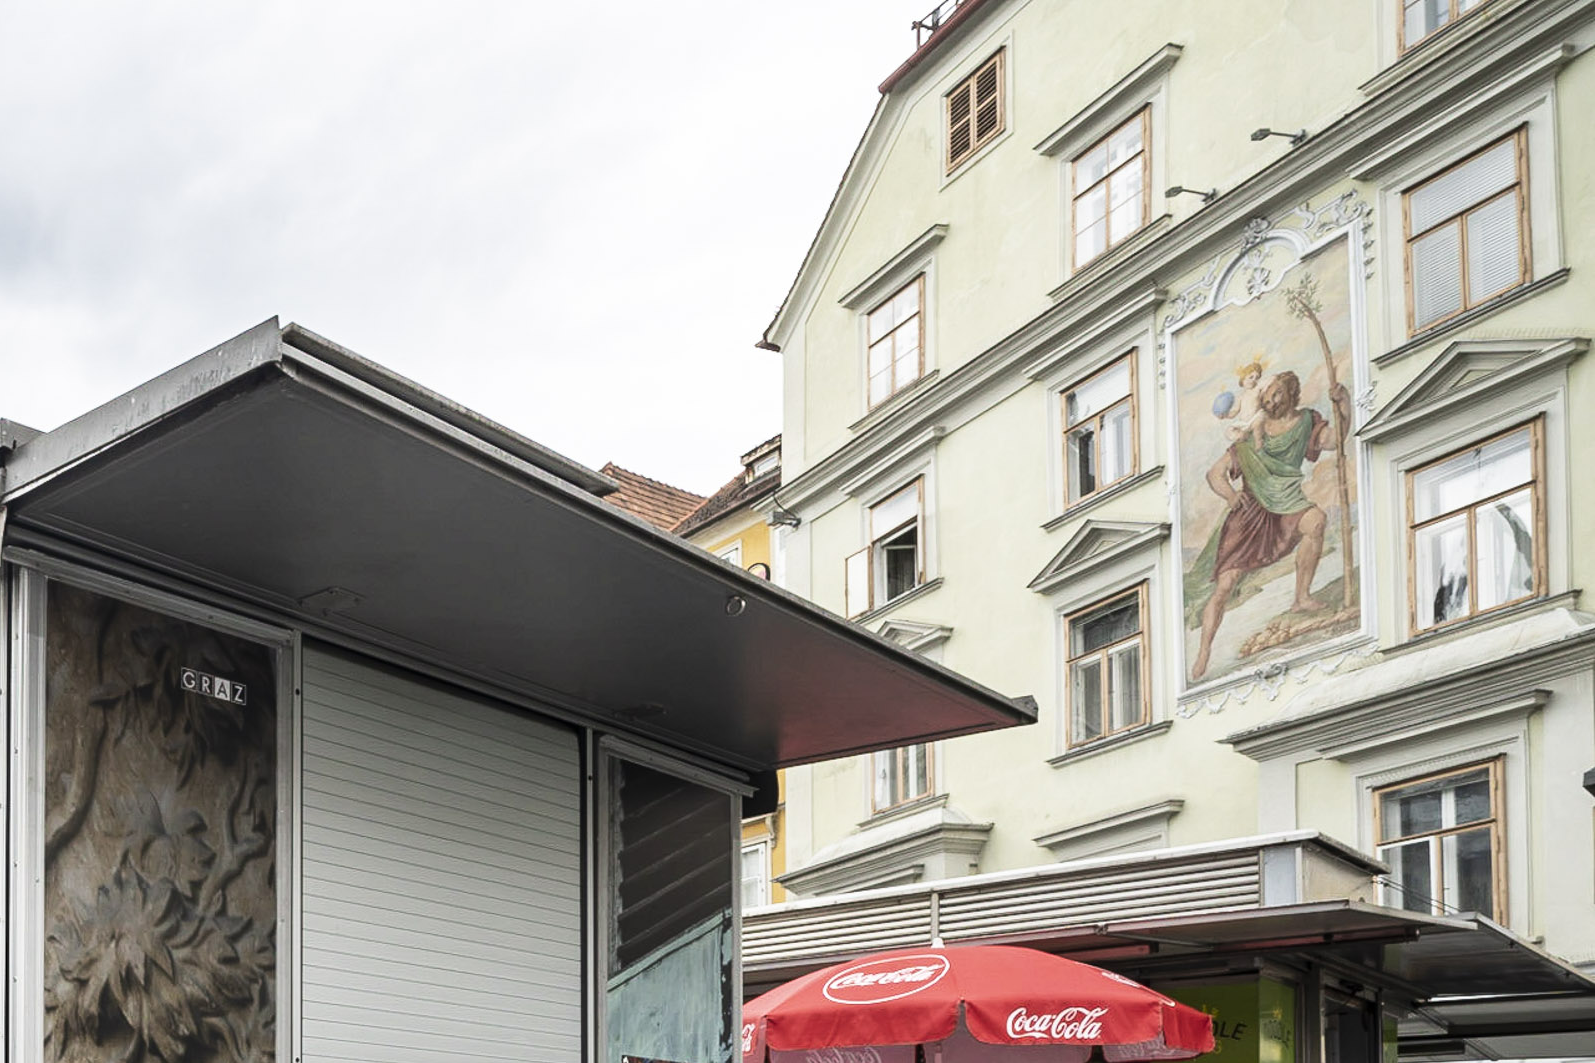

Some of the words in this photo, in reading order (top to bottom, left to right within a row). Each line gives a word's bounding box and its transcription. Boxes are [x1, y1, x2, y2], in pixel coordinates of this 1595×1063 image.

[182, 669, 245, 704] GRAZ
[830, 964, 945, 989] Coca-Cola
[1006, 1007, 1108, 1039] Coca-Cola
